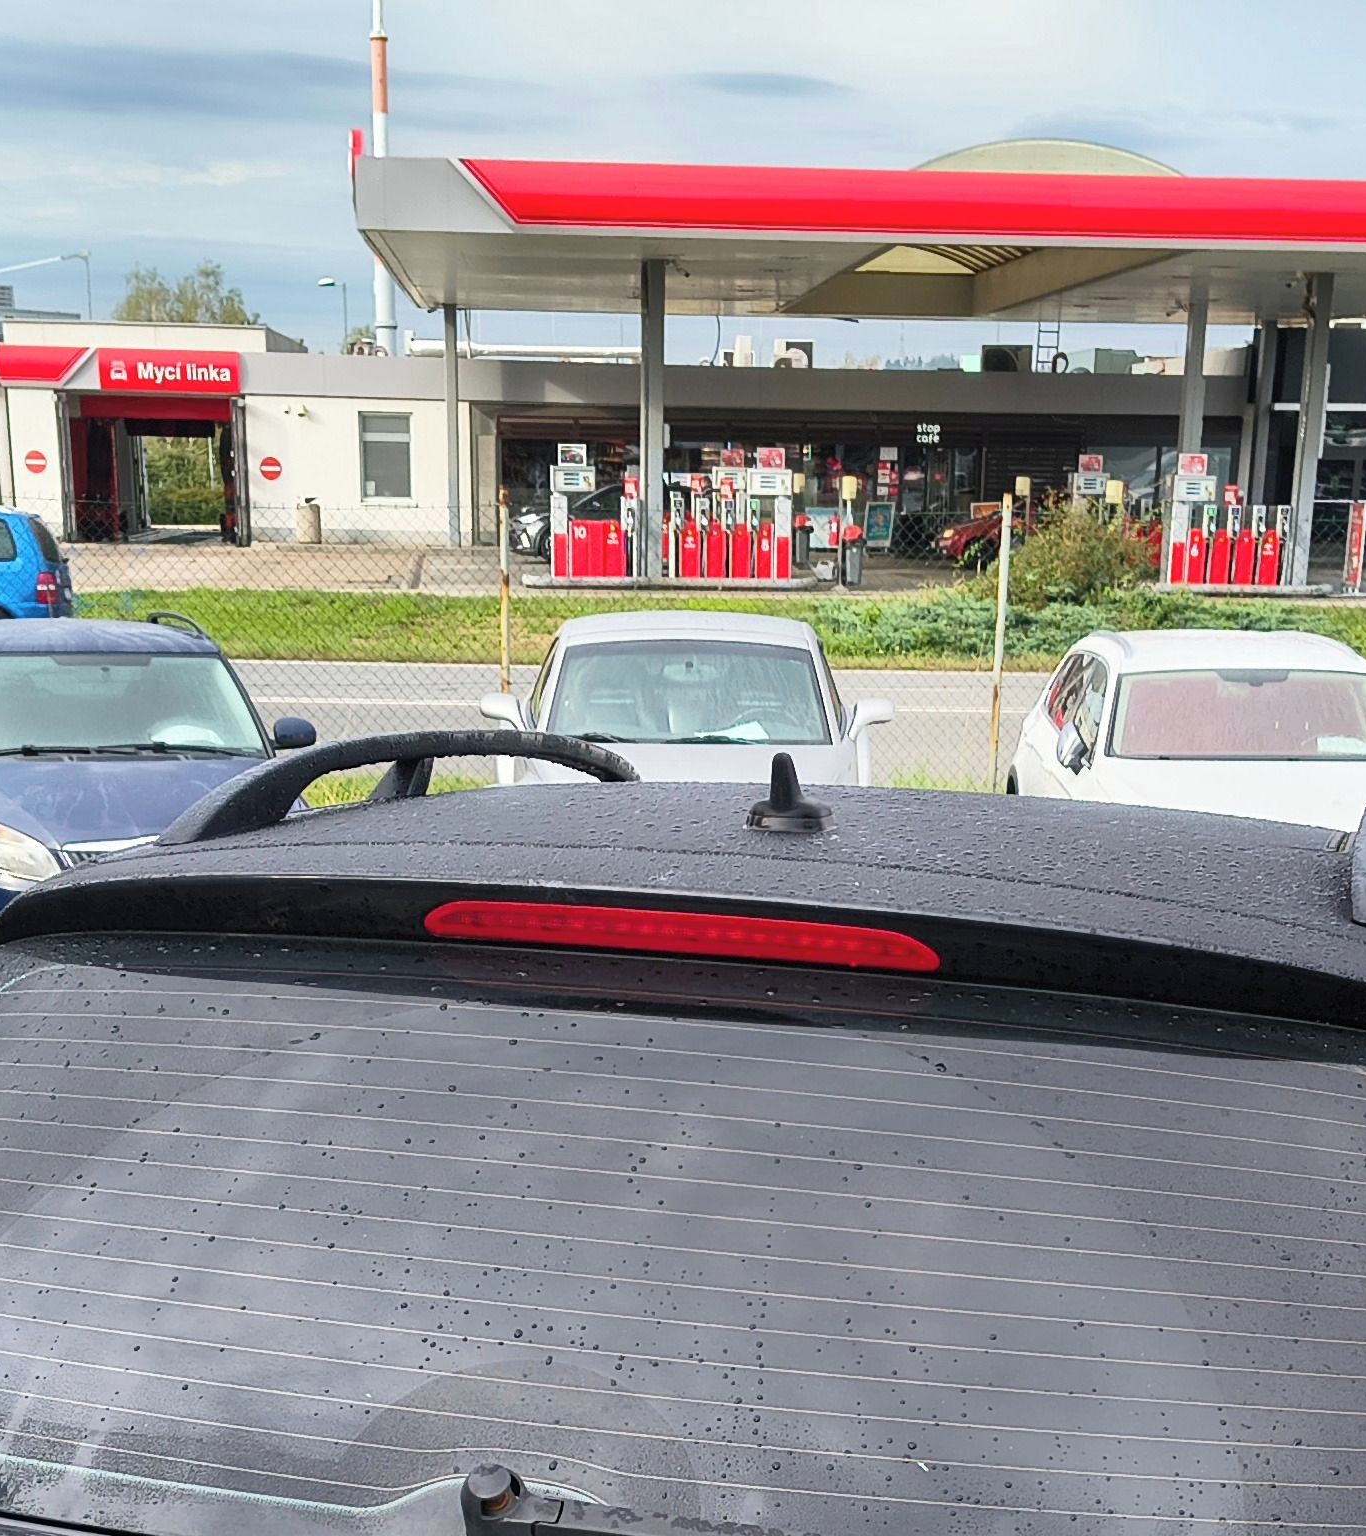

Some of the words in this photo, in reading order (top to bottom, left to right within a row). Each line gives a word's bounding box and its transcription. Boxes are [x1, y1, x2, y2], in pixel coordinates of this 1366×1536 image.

[137, 362, 181, 384] Mycí
[186, 363, 231, 382] linka
[916, 423, 941, 435] stop
[573, 525, 587, 539] 10
